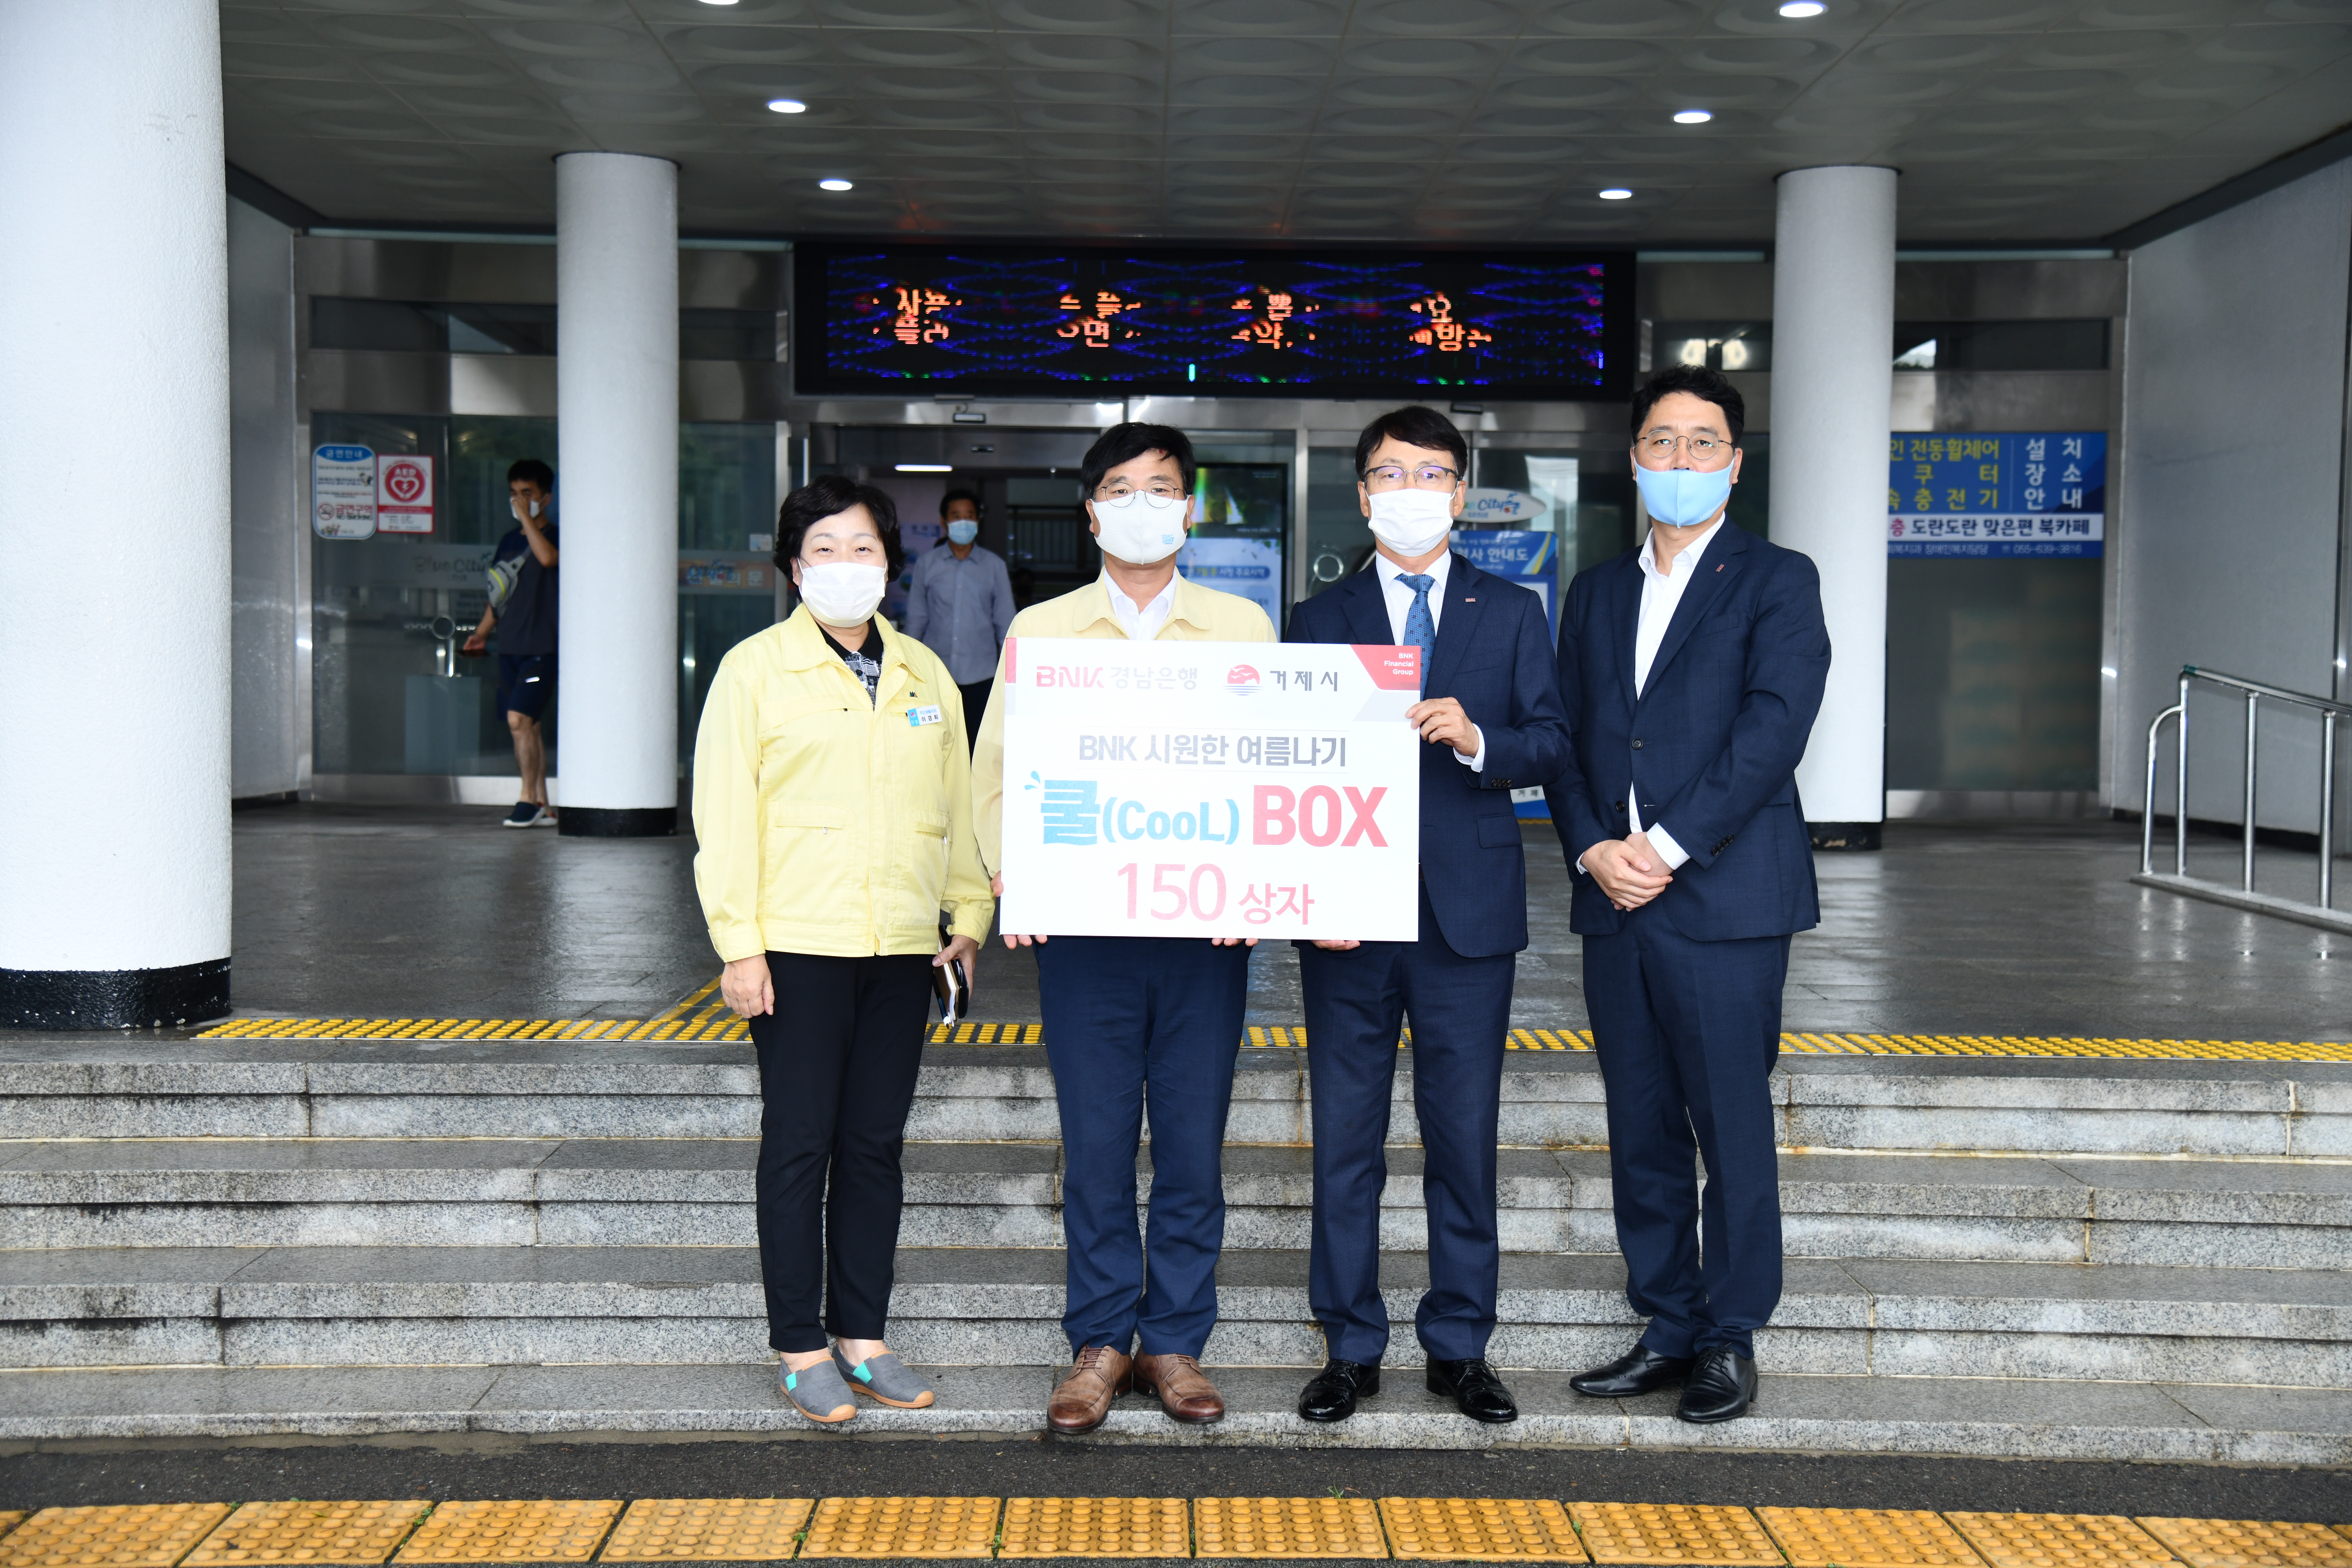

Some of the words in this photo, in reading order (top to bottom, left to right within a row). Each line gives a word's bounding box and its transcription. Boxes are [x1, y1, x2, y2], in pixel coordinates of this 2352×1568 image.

[1910, 438, 1999, 462] 전동휠체어
[336, 505, 373, 515] 금연구역
[1911, 519, 1977, 537] 도란도란
[1983, 519, 2034, 537] 맞은편
[2039, 519, 2090, 537] 북카페
[1487, 547, 1529, 563] 안내도
[1036, 665, 1105, 688] BNK
[1110, 667, 1198, 691] 경남은행
[1079, 735, 1138, 761] BNK
[1144, 734, 1229, 766] 시원한
[1237, 736, 1346, 767] 여름나기
[1253, 785, 1389, 847] BOX
[1117, 863, 1227, 922] 150
[1238, 883, 1315, 925] 상자
